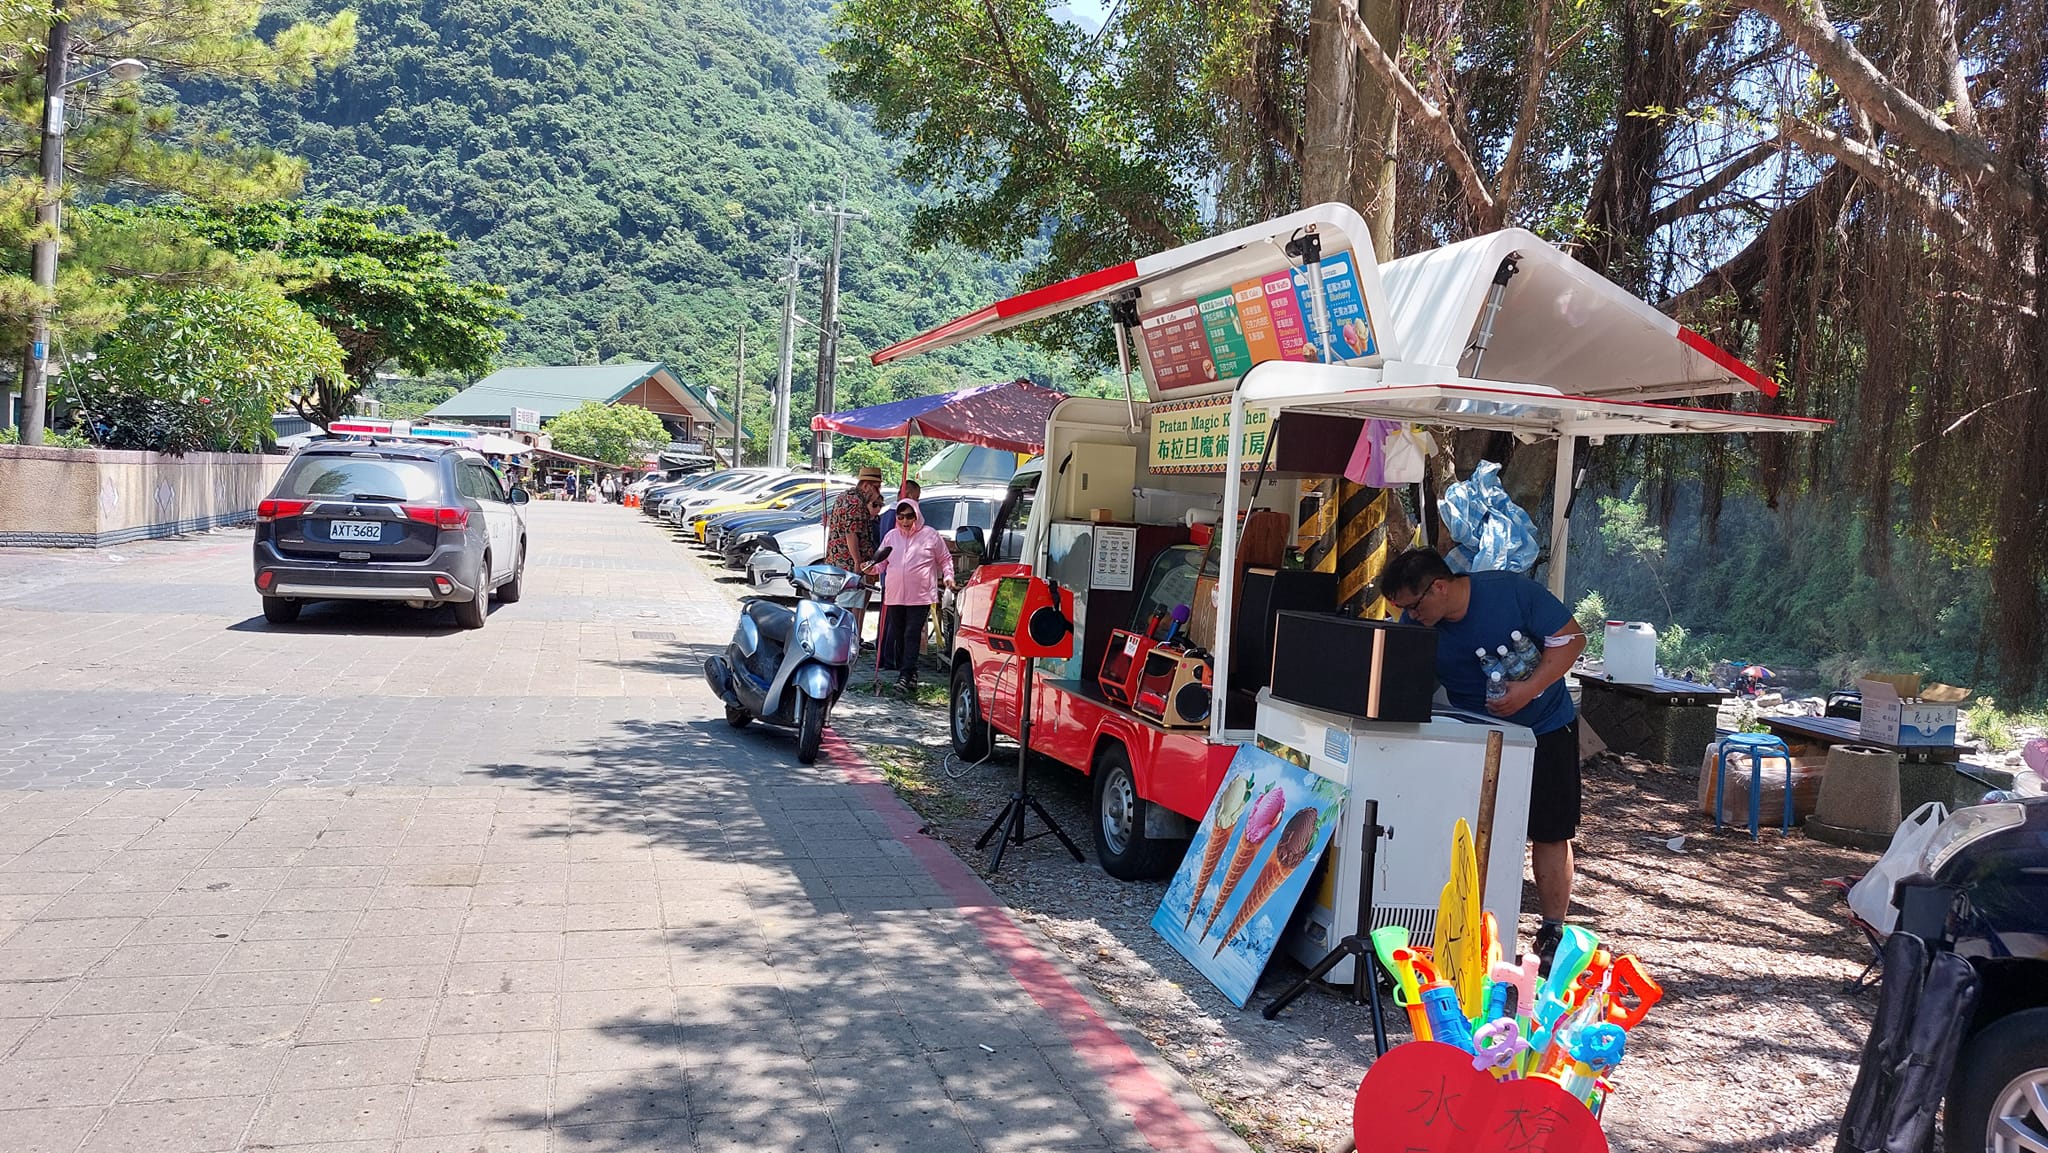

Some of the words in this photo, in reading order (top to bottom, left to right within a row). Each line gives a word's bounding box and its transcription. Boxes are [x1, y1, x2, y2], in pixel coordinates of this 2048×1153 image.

[1159, 419, 1187, 433] Pratan
[1191, 414, 1219, 433] Magic
[1223, 410, 1266, 427] Khen
[1157, 431, 1266, 460] 布拉旦魔術房
